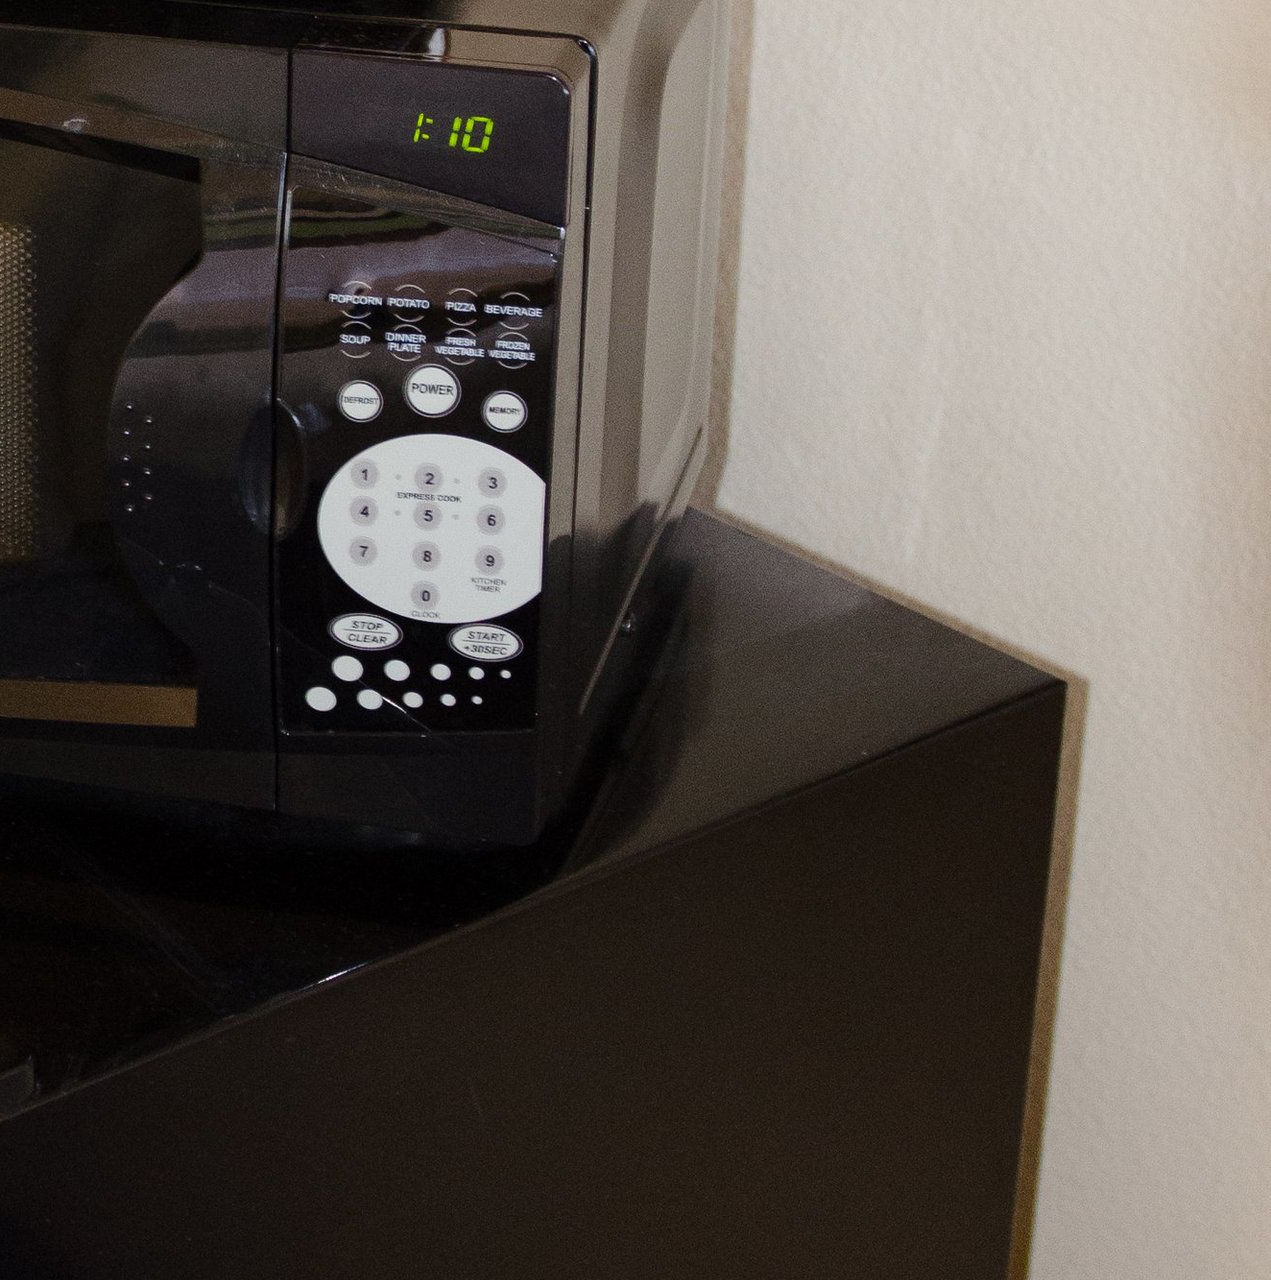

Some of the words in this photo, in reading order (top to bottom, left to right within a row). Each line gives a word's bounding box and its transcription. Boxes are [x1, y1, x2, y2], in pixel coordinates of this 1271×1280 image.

[413, 113, 494, 153] 1:10
[328, 293, 383, 306] POPCORN
[386, 297, 430, 310] POTATO
[445, 301, 477, 313] PIZZA
[484, 304, 543, 318] BEVERAGE
[339, 334, 371, 345] SOUP
[385, 332, 426, 344] DINNER
[445, 336, 476, 348] FRESH
[387, 343, 422, 354] PLATE
[434, 345, 485, 358] VEGETABLE
[495, 340, 531, 352] FROZEN
[488, 350, 536, 362] VEGETABLE
[411, 382, 454, 396] POWER
[343, 395, 379, 406] DEFROST
[489, 406, 522, 416] MEMORY
[361, 468, 369, 481] 1
[425, 472, 435, 485] 2
[488, 477, 498, 489] 3
[397, 491, 436, 502] EXPRESS
[438, 494, 462, 504] COOK
[360, 505, 370, 517] 4
[424, 509, 433, 522] 5
[487, 514, 496, 526] 6
[359, 545, 369, 558] 7
[423, 550, 432, 563] 8
[485, 555, 495, 567] 9
[471, 576, 507, 587] KITCHEN
[475, 584, 501, 593] TIMER
[422, 590, 431, 602] 0
[411, 609, 441, 620] CLOCK
[352, 620, 384, 631] STOP
[348, 632, 388, 645] CLEAR
[467, 630, 506, 642] START
[463, 643, 508, 656] +30SEC
